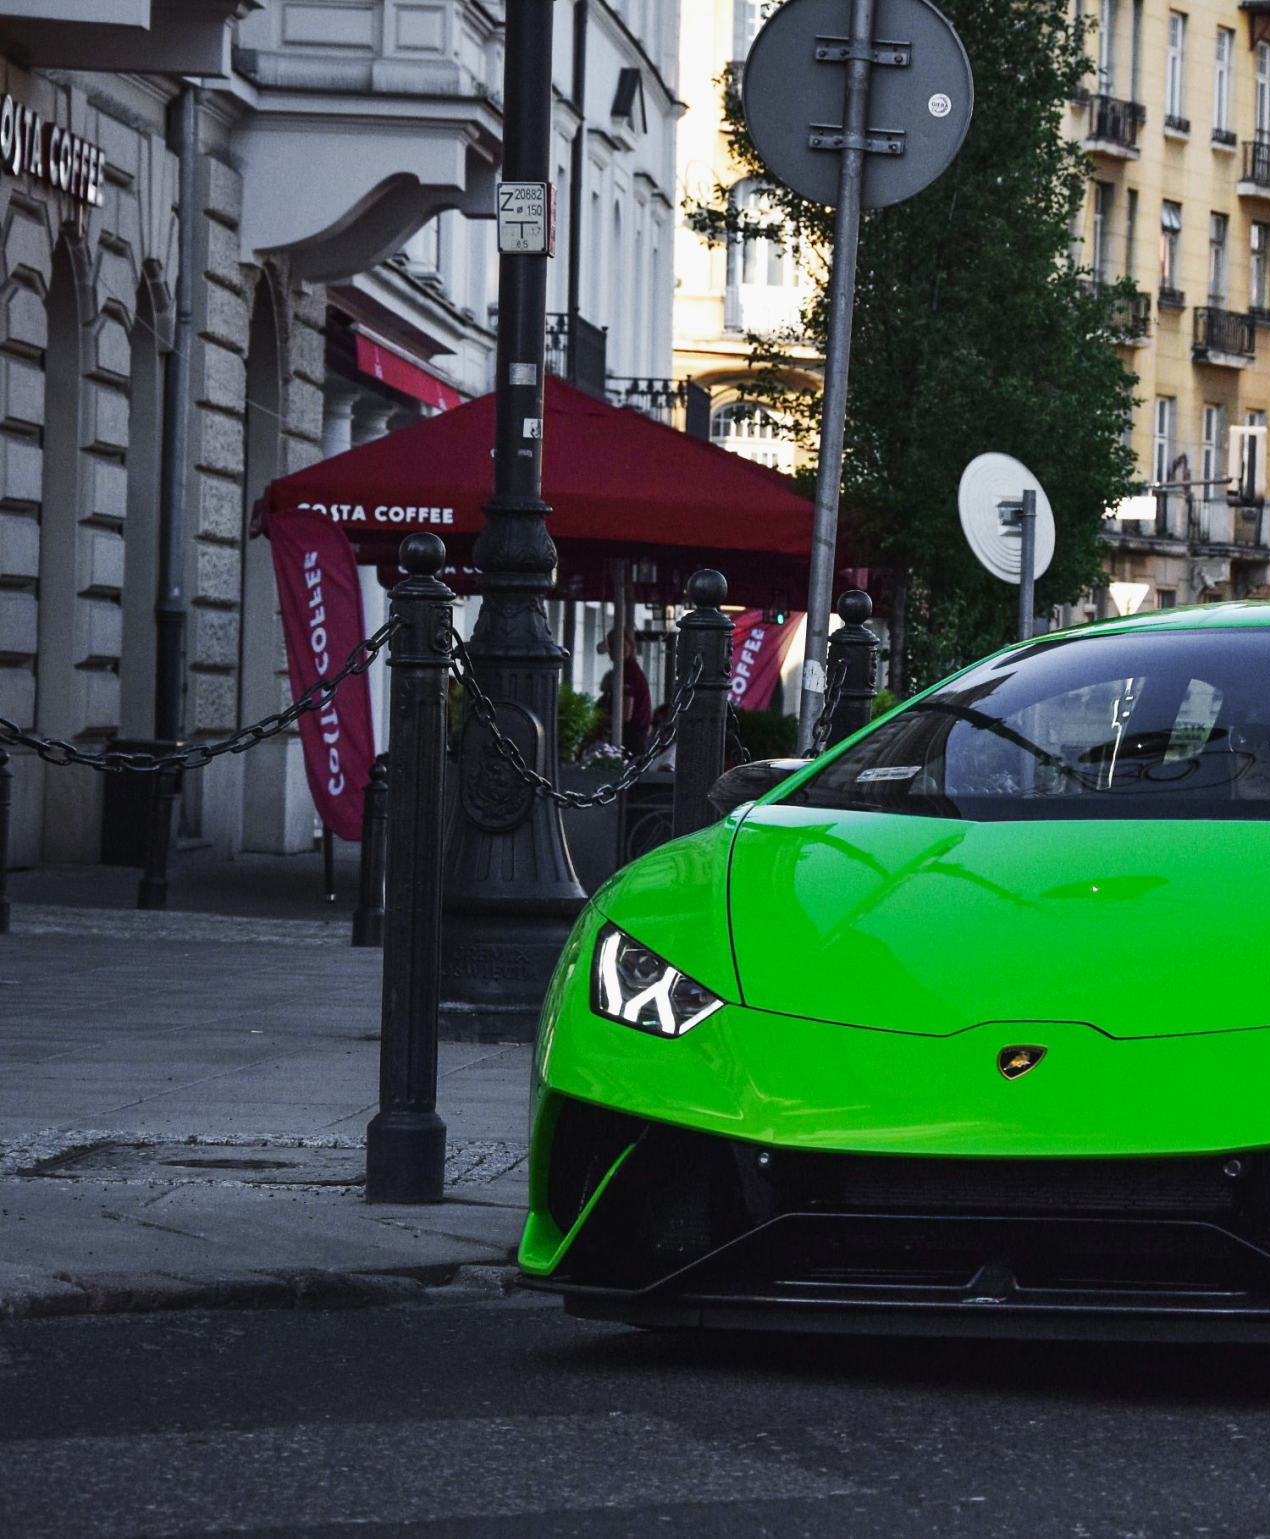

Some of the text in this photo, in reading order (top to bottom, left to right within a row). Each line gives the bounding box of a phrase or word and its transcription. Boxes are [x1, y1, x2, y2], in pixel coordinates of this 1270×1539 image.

[0, 94, 105, 206] OSTA COFFEE
[500, 188, 543, 212] Z 20882
[527, 205, 543, 217] 150
[374, 506, 454, 525] COFFEE
